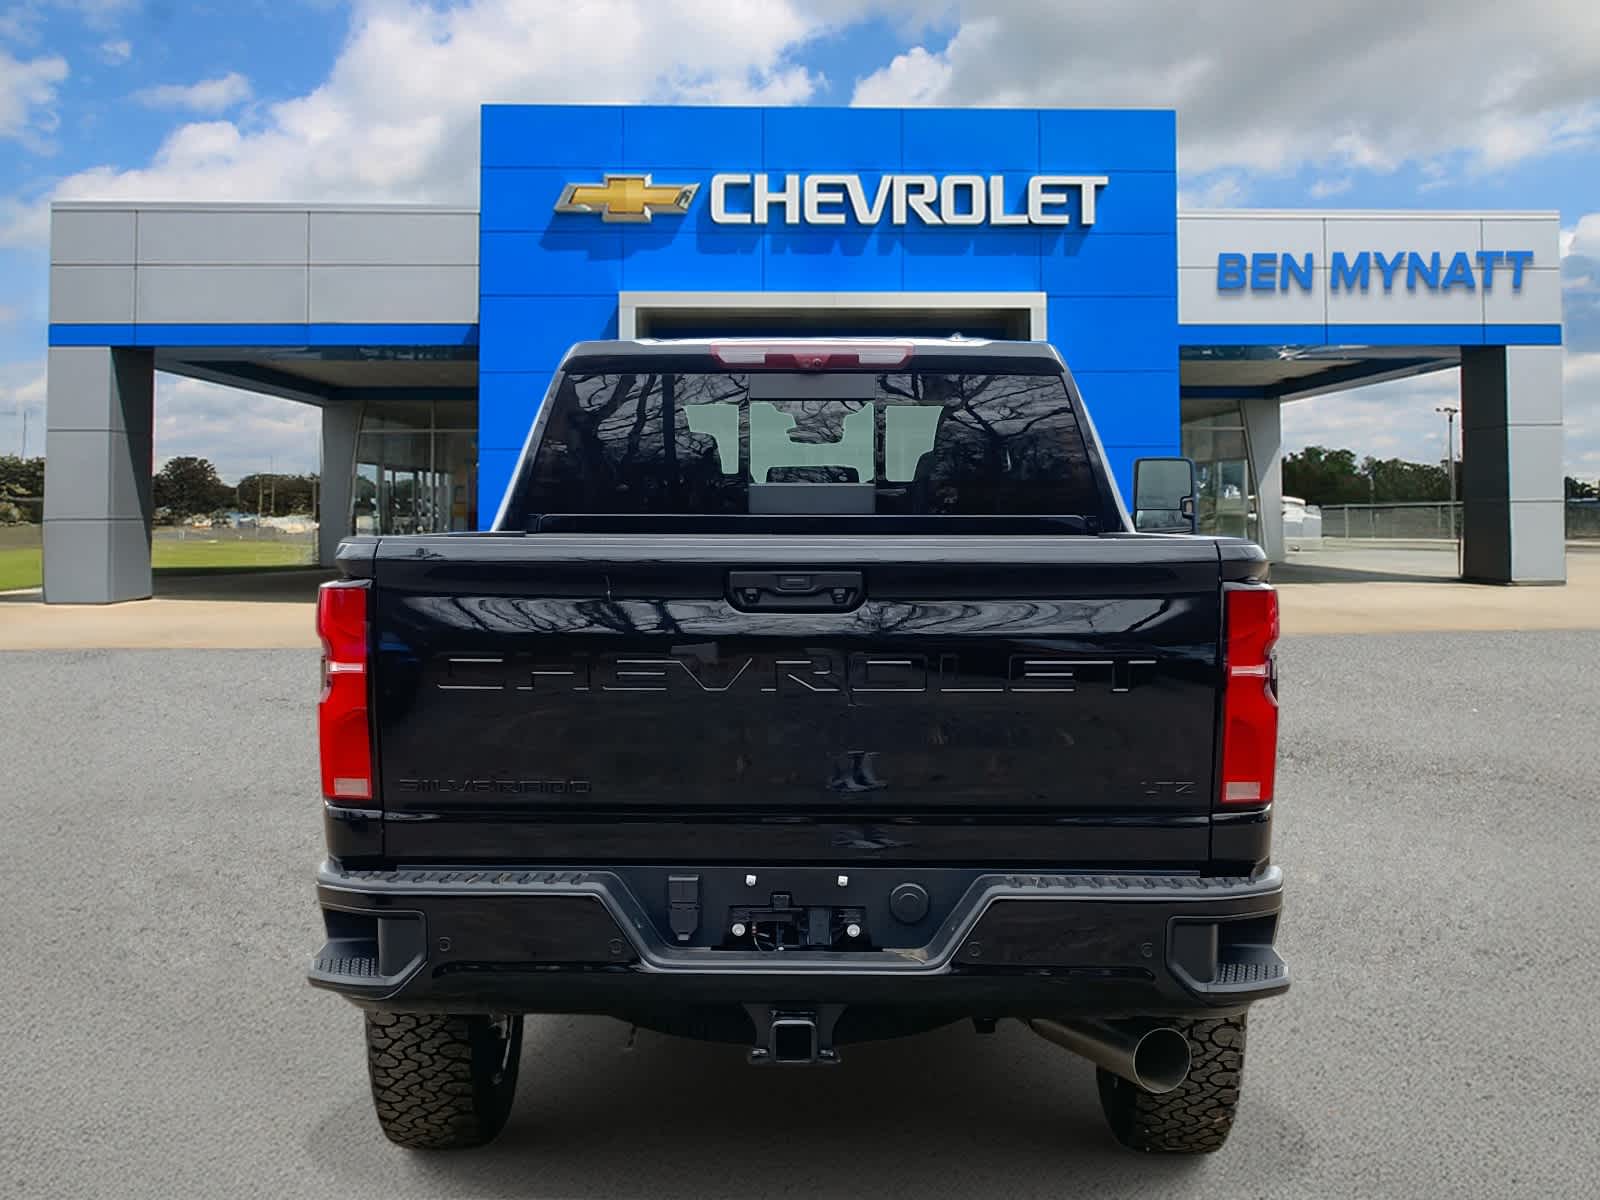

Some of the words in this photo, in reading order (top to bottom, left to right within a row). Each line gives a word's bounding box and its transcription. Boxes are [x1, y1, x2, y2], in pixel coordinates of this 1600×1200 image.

[710, 173, 1109, 226] CHEVROLET
[1216, 252, 1314, 291] BEN
[1330, 250, 1535, 290] MYNATT
[435, 653, 1159, 693] CHEVROLET
[398, 776, 592, 793] SILVERADO
[1138, 778, 1197, 796] LTZ
